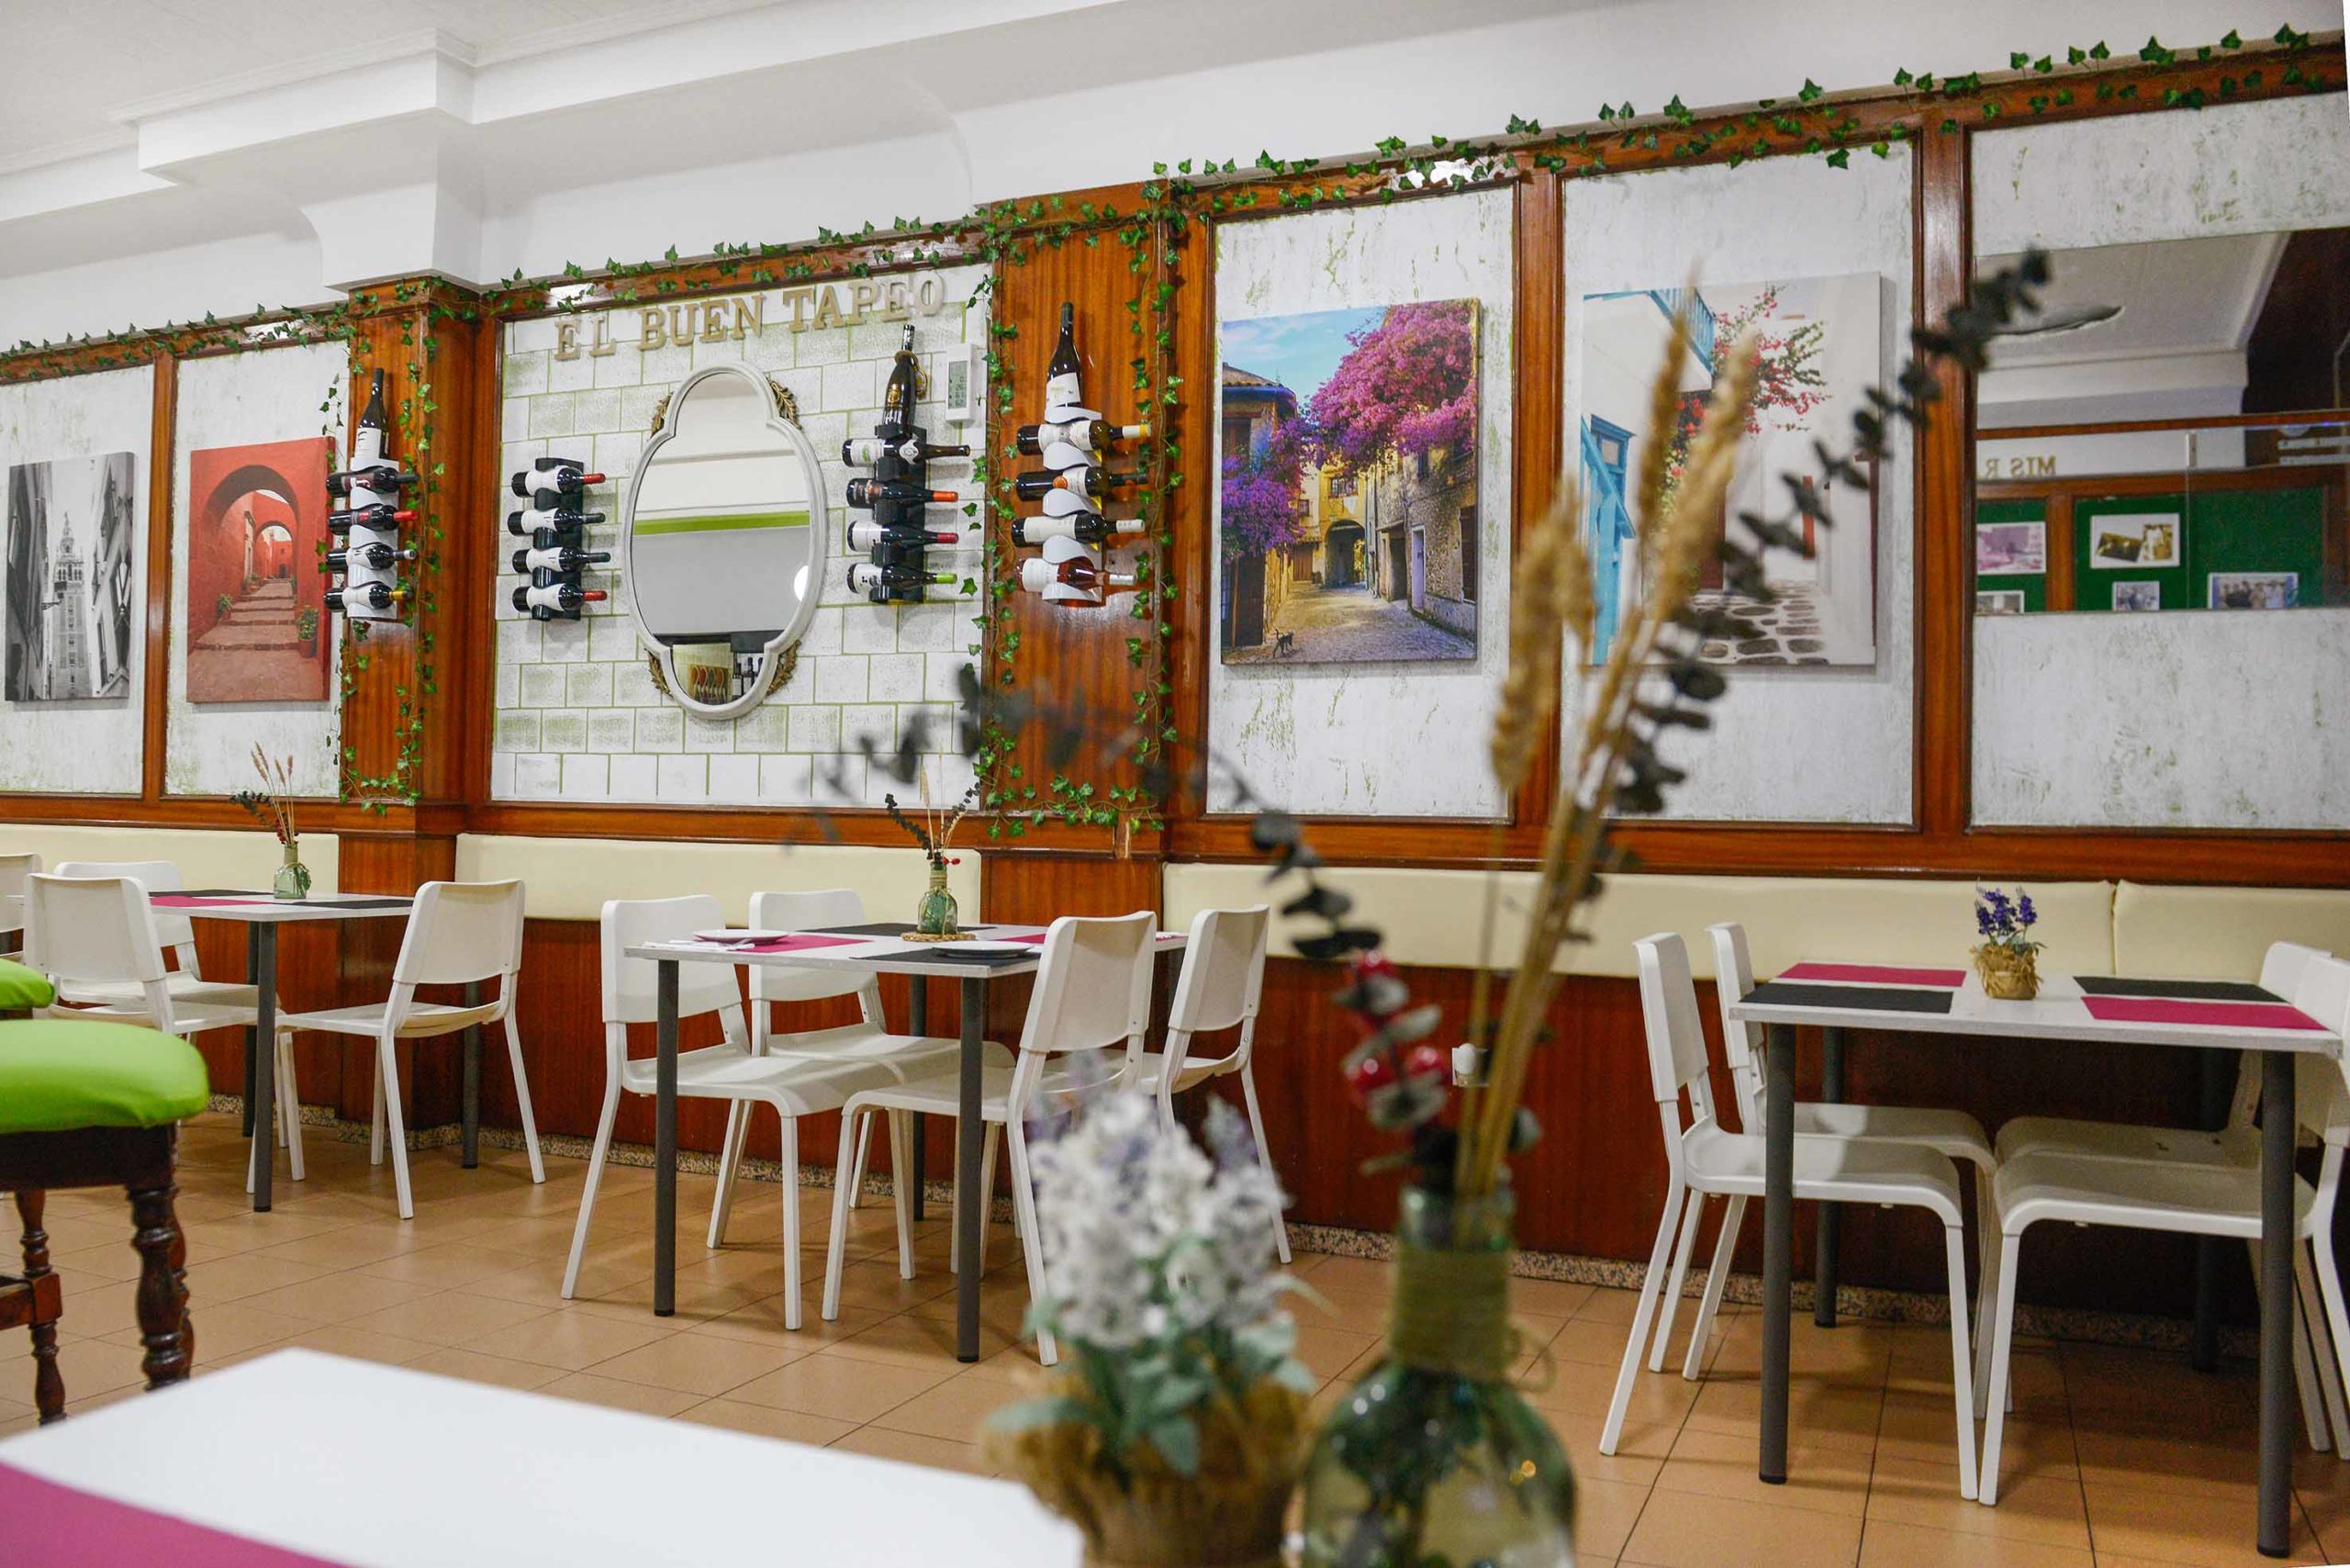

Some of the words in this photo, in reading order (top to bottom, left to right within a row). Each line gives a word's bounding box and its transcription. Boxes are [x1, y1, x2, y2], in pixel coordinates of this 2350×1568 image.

[554, 314, 616, 362] EL
[638, 292, 766, 352] BUEN
[782, 270, 946, 334] TAPEO
